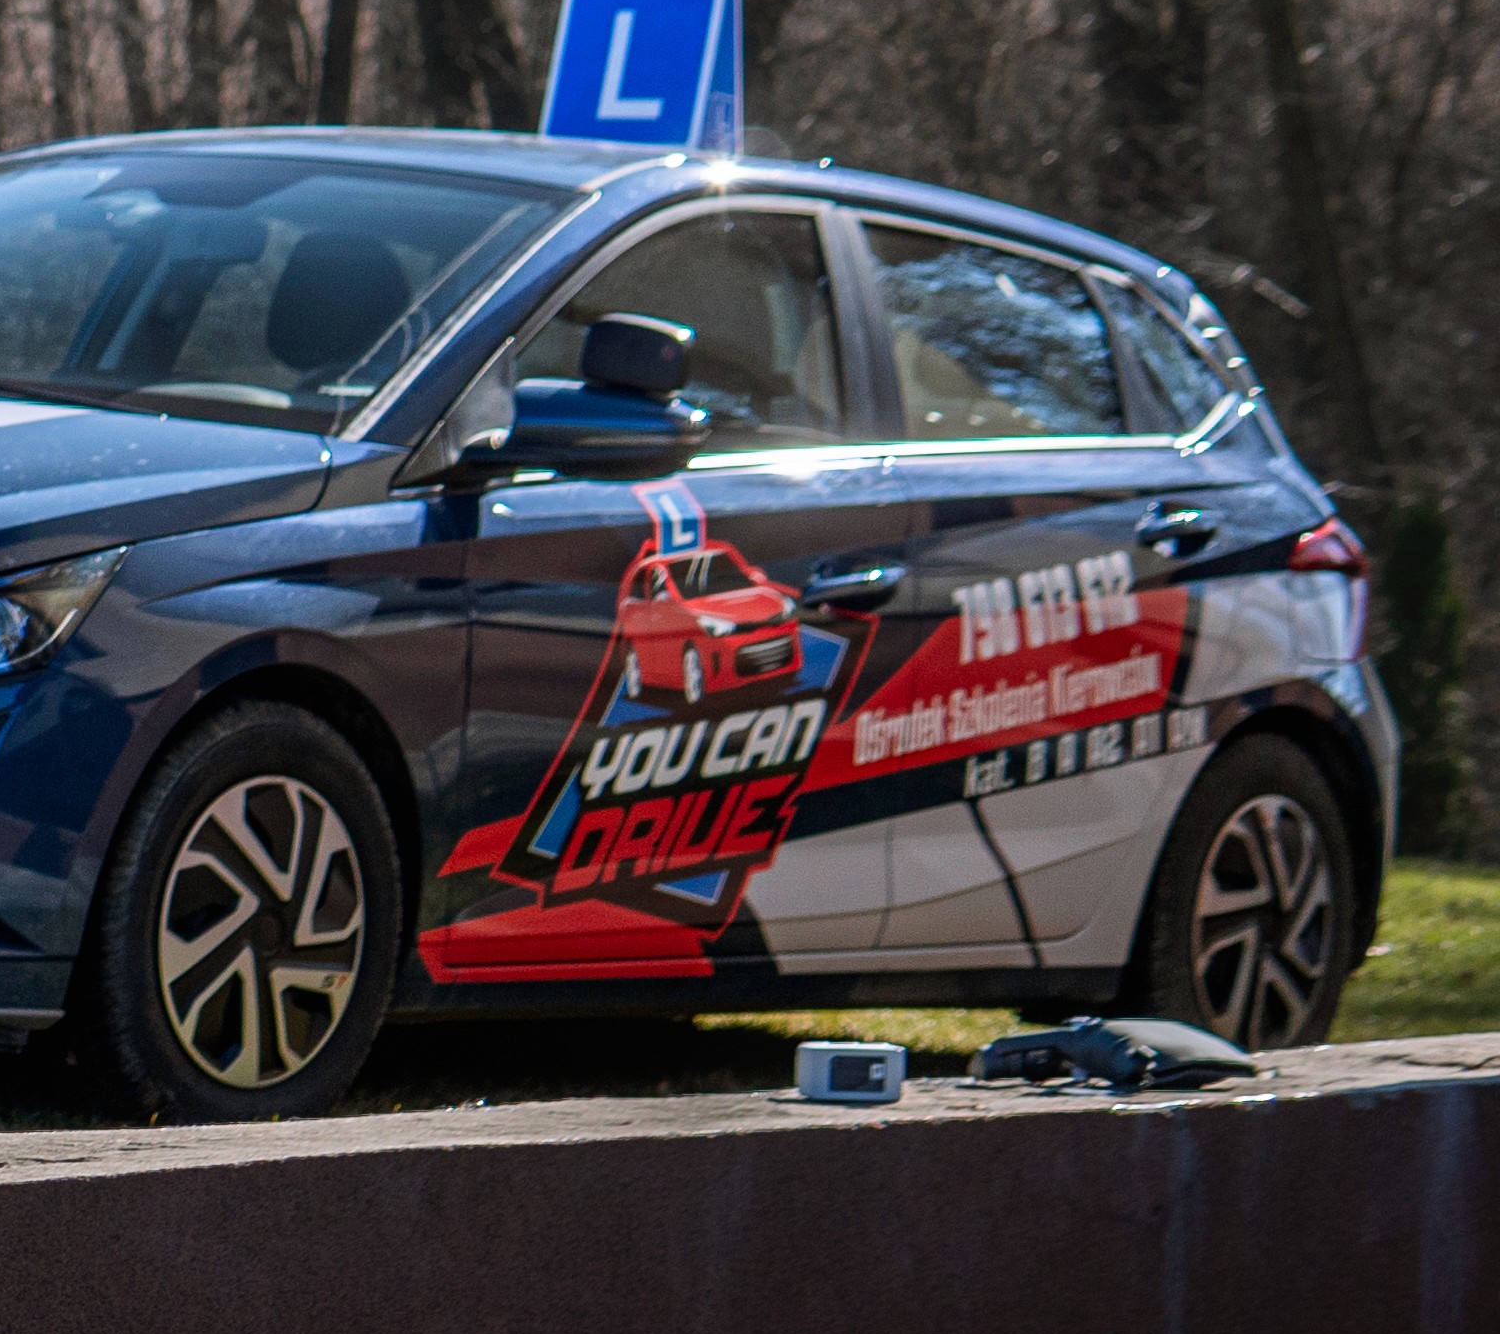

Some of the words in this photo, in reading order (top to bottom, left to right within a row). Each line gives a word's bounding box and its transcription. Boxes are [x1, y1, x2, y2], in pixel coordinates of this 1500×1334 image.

[596, 8, 665, 121] L
[659, 493, 696, 547] L
[580, 719, 710, 801] YOU
[700, 698, 828, 778] CAN
[551, 772, 799, 894] DRIVE
